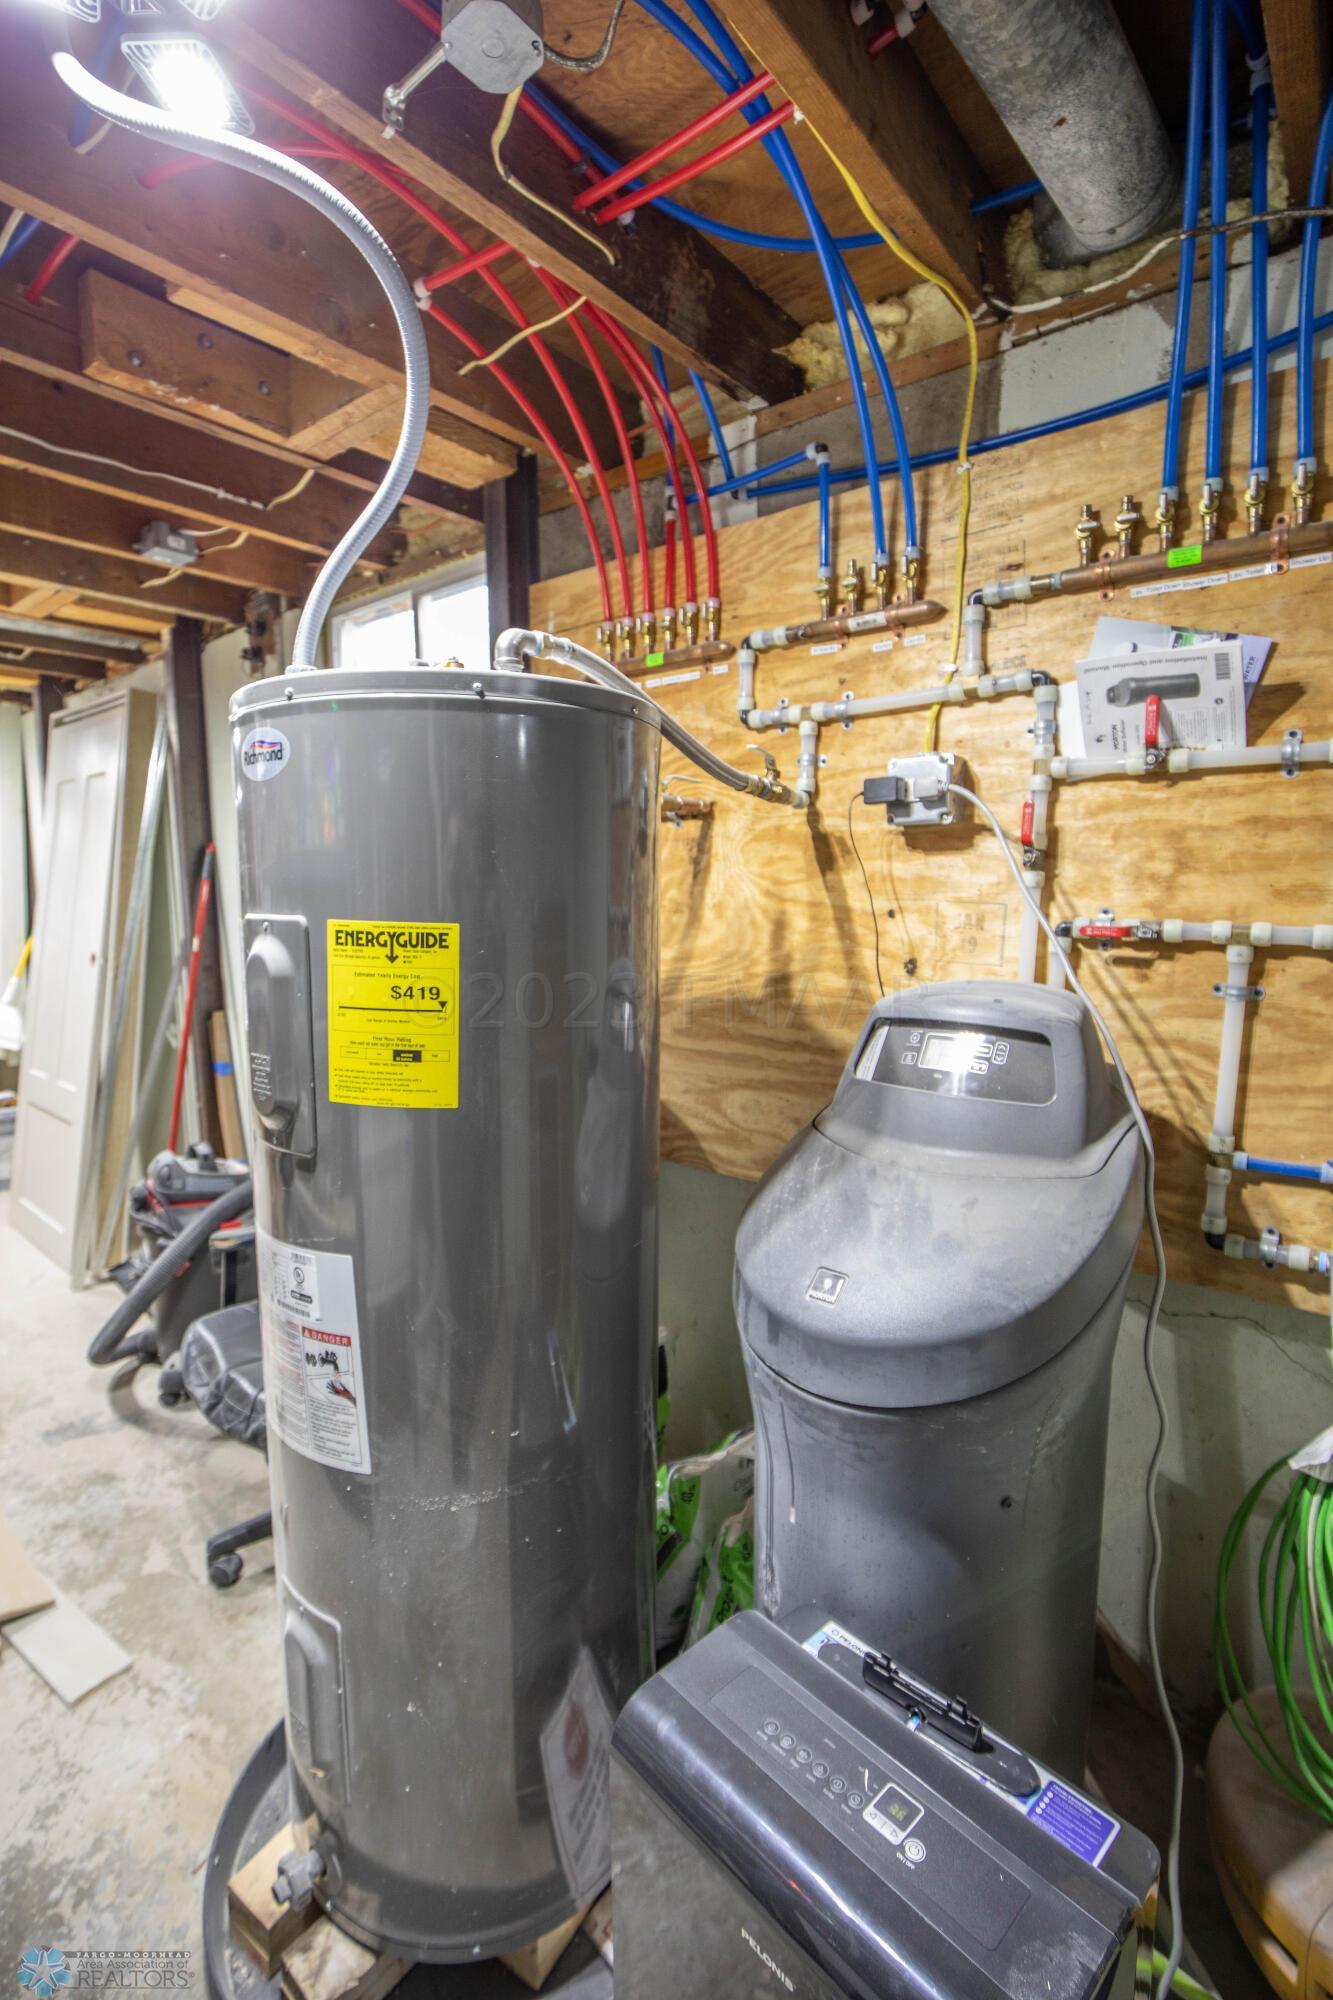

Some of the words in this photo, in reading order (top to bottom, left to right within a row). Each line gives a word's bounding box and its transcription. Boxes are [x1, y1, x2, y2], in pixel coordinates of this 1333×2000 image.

[244, 741, 283, 766] Richmond
[335, 929, 450, 952] ENERGYGUIDE
[390, 985, 441, 1001] $419
[311, 1330, 350, 1346] DANGER
[741, 1927, 794, 1993] PELONIS
